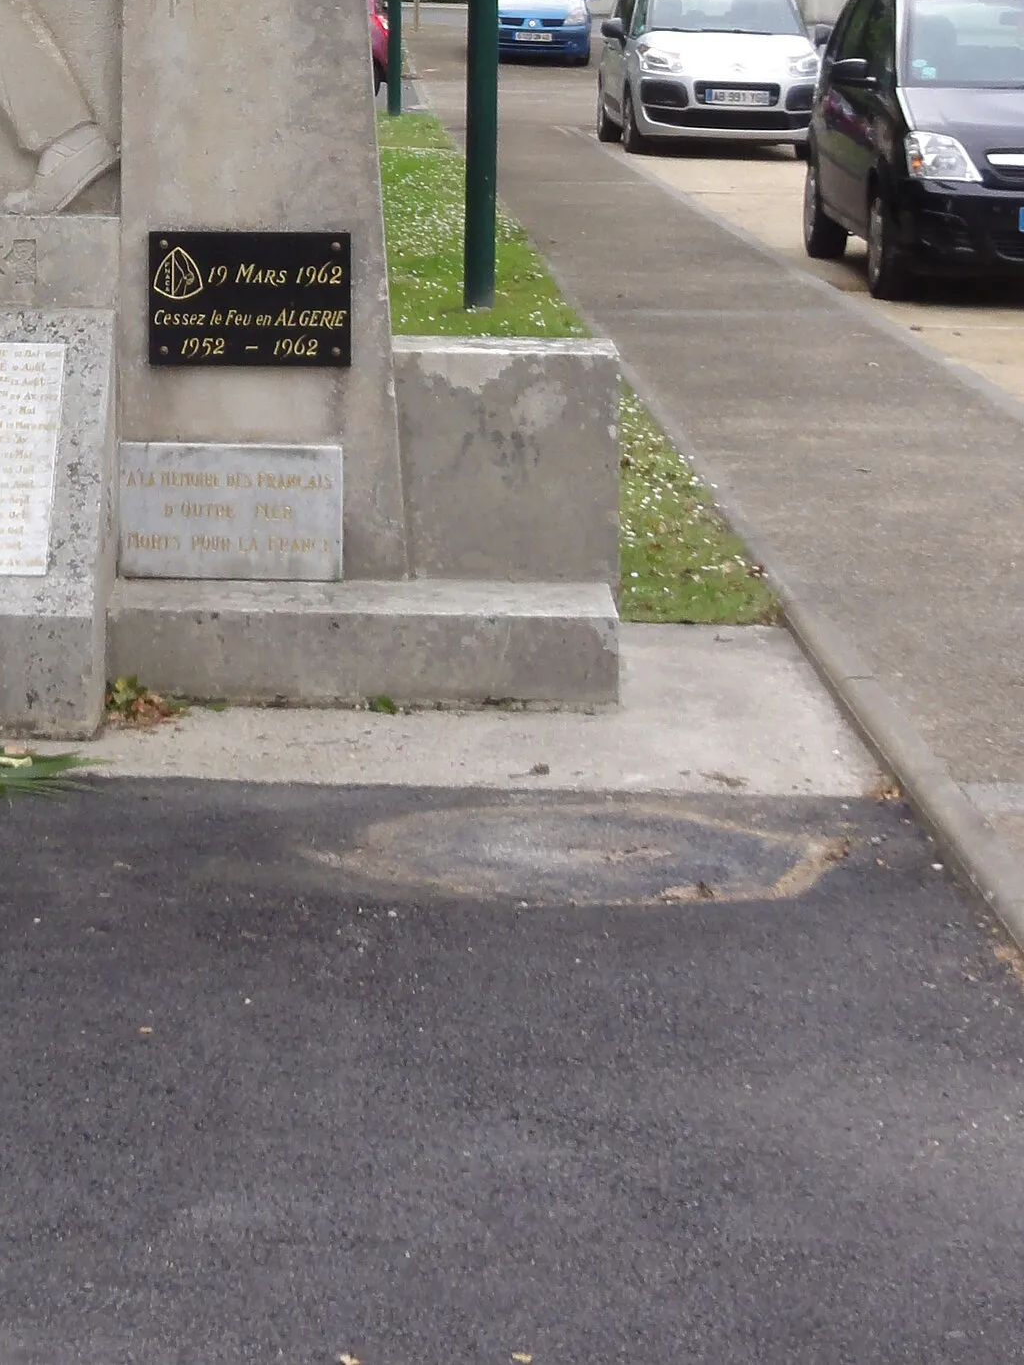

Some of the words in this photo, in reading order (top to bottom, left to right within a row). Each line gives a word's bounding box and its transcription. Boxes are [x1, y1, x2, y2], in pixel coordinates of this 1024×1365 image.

[208, 266, 227, 286] 19
[296, 259, 342, 287] 1962
[154, 309, 206, 326] Cessez
[210, 309, 222, 326] le
[225, 309, 251, 326] Feu
[256, 314, 271, 326] en
[274, 308, 347, 329] ALGERIE
[181, 337, 225, 359] 1952
[273, 335, 318, 360] 1962
[226, 473, 252, 488] DES
[191, 535, 233, 552] POUR
[238, 536, 258, 553] LA
